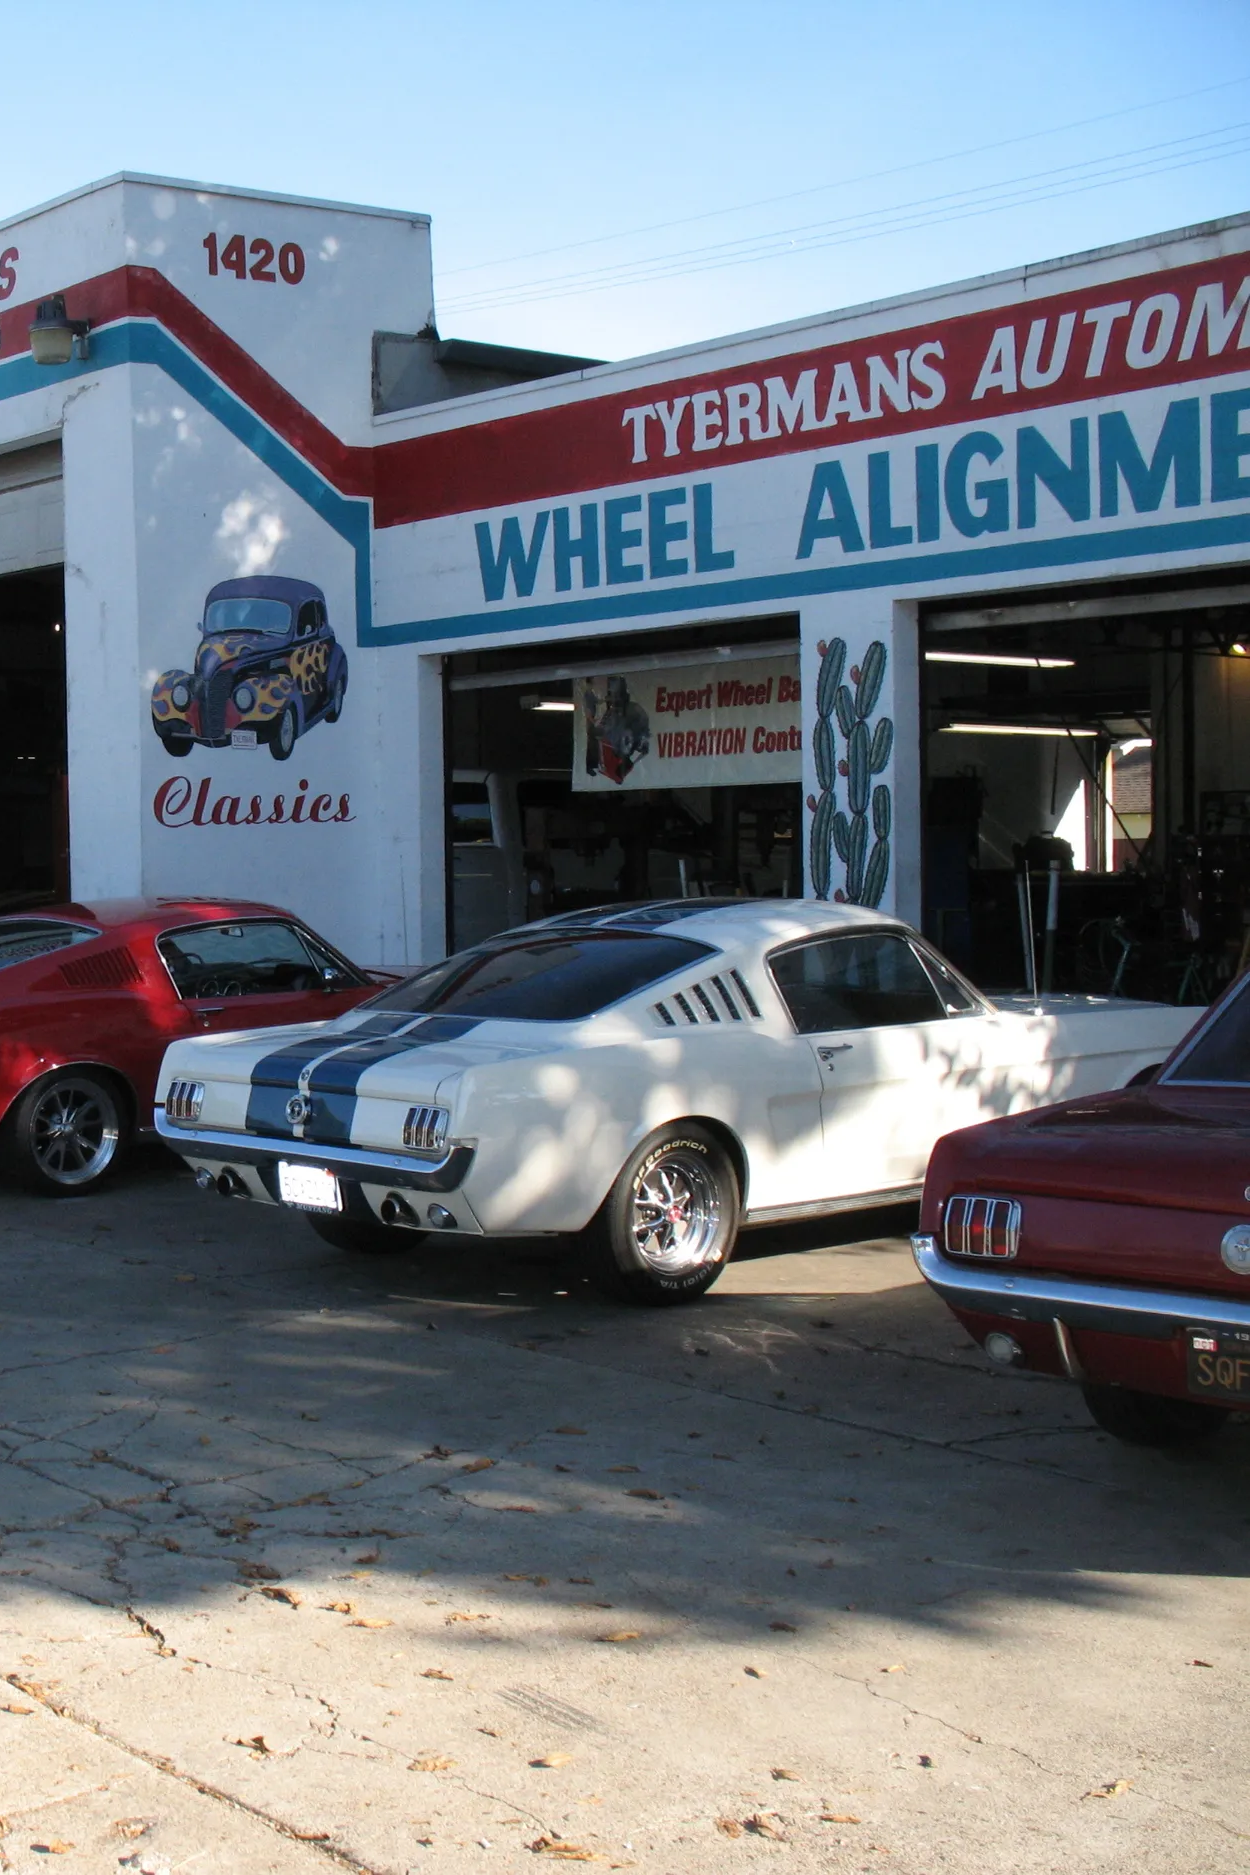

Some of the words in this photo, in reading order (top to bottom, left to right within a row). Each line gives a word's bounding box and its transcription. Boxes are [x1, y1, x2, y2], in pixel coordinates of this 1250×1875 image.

[203, 232, 305, 285] 1420
[622, 340, 947, 464] TYERMANS
[971, 276, 1250, 400] AUTOM
[473, 482, 735, 603] WHEEL
[795, 387, 1250, 560] ALIGNME
[655, 684, 713, 717] Expert
[717, 676, 774, 708] Wheel
[657, 726, 747, 758] VIBRATION
[154, 776, 357, 828] Classics
